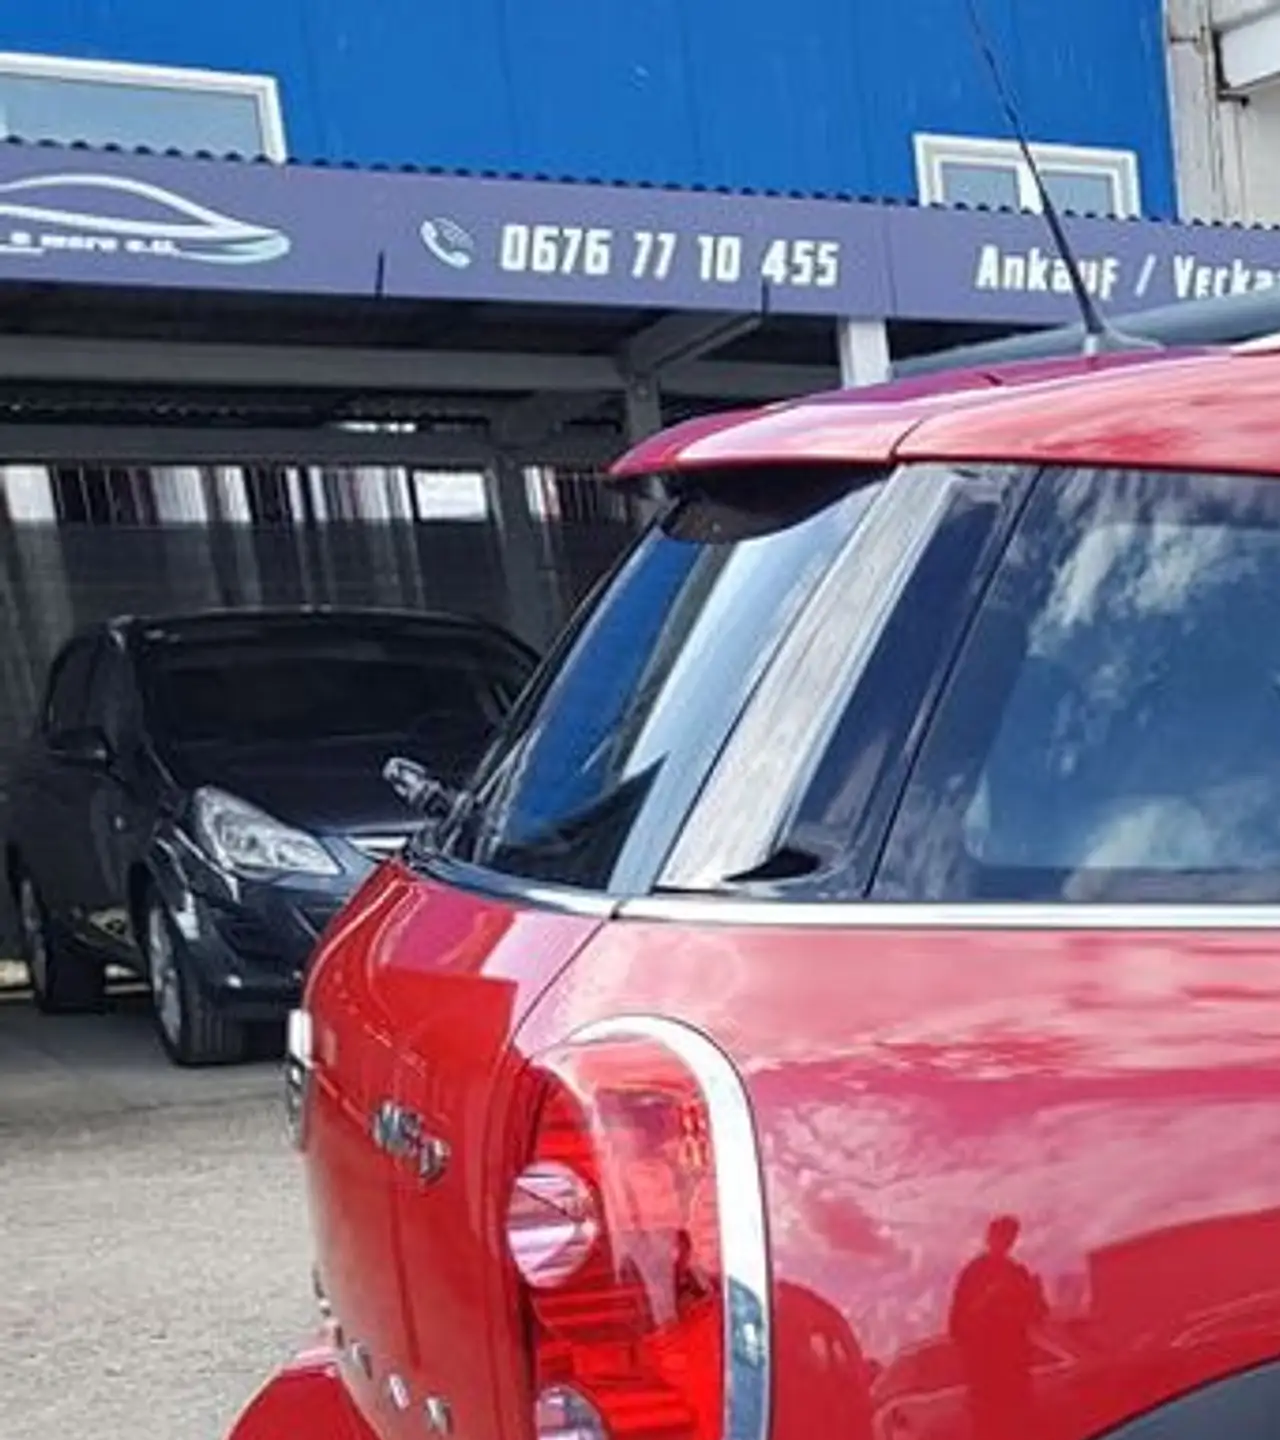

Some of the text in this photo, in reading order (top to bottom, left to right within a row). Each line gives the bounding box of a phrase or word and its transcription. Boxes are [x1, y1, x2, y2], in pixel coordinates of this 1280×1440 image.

[501, 223, 840, 287] 0676 77 10 455
[974, 243, 1120, 301] Ankauf
[1133, 253, 1157, 298] /
